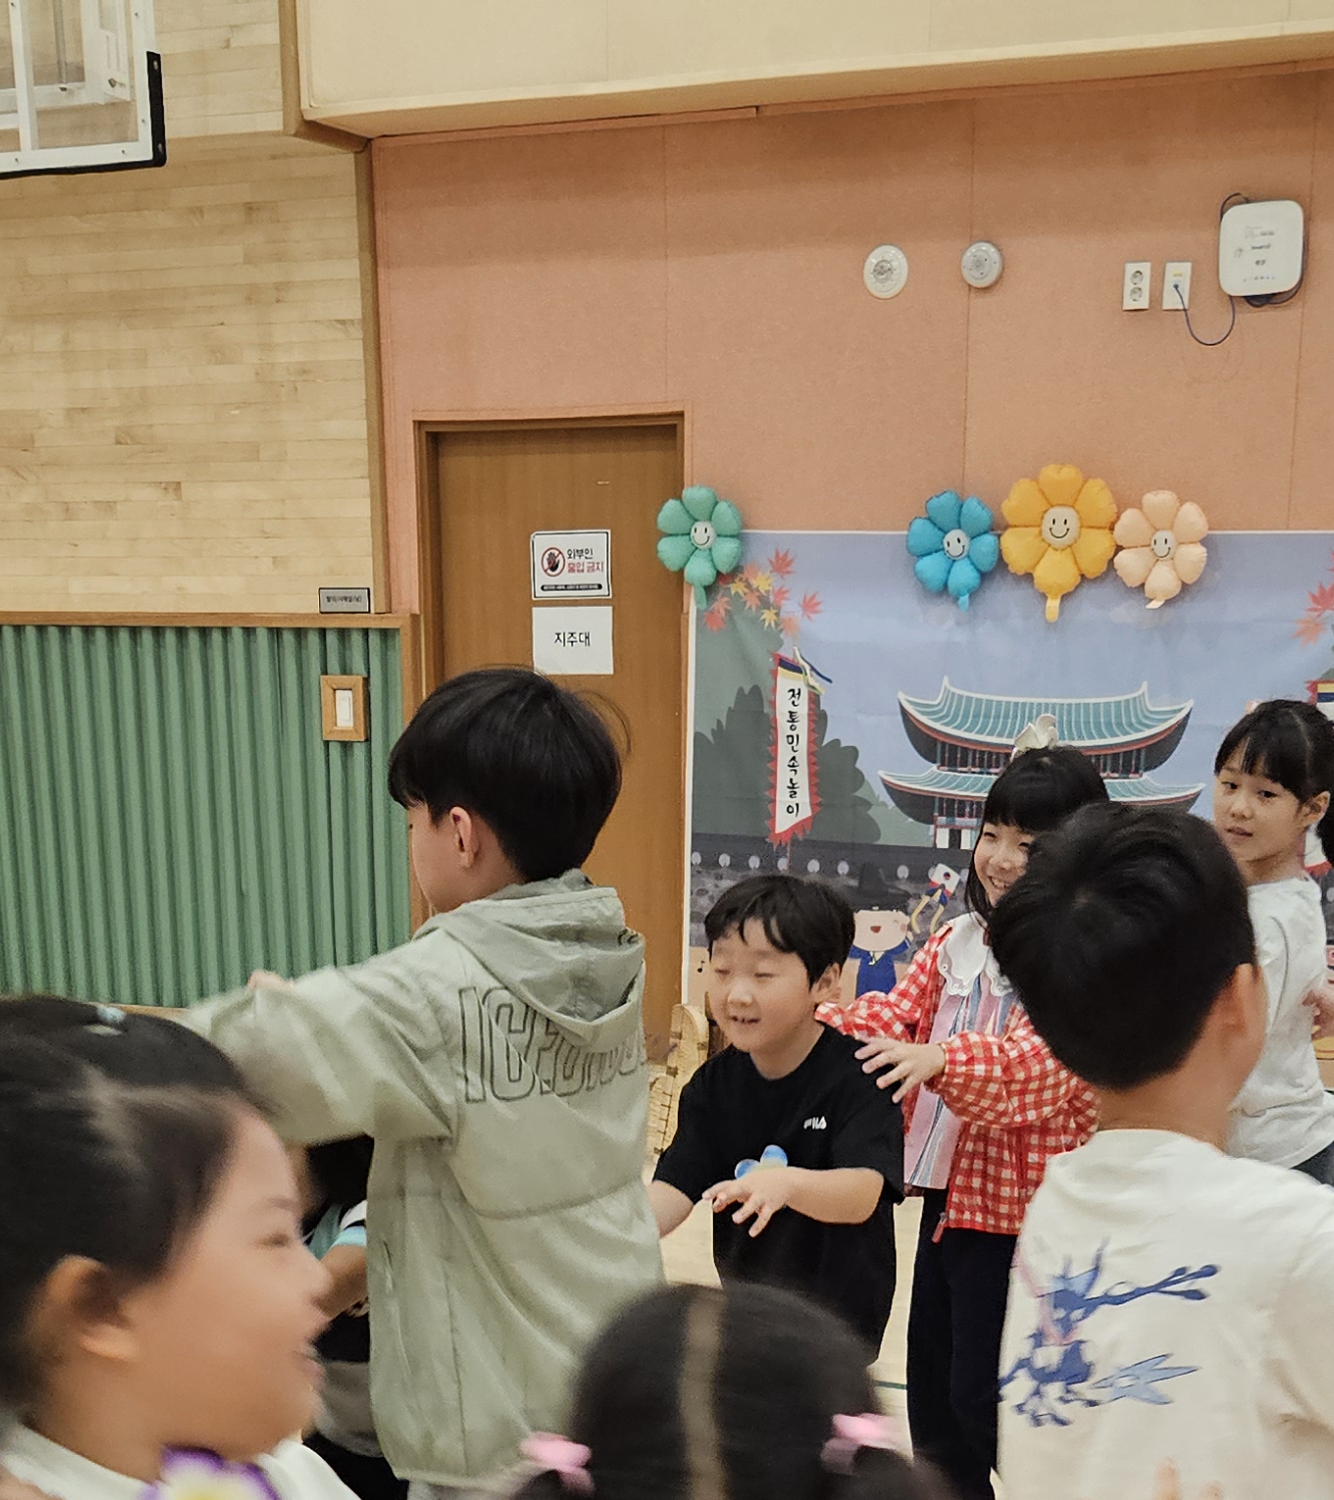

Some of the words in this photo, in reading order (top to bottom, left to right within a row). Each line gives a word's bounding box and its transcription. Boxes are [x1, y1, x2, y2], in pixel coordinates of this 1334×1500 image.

[567, 548, 593, 560] 외부인
[568, 562, 585, 573] 출입
[587, 561, 604, 573] 금지
[554, 631, 591, 647] 지주대
